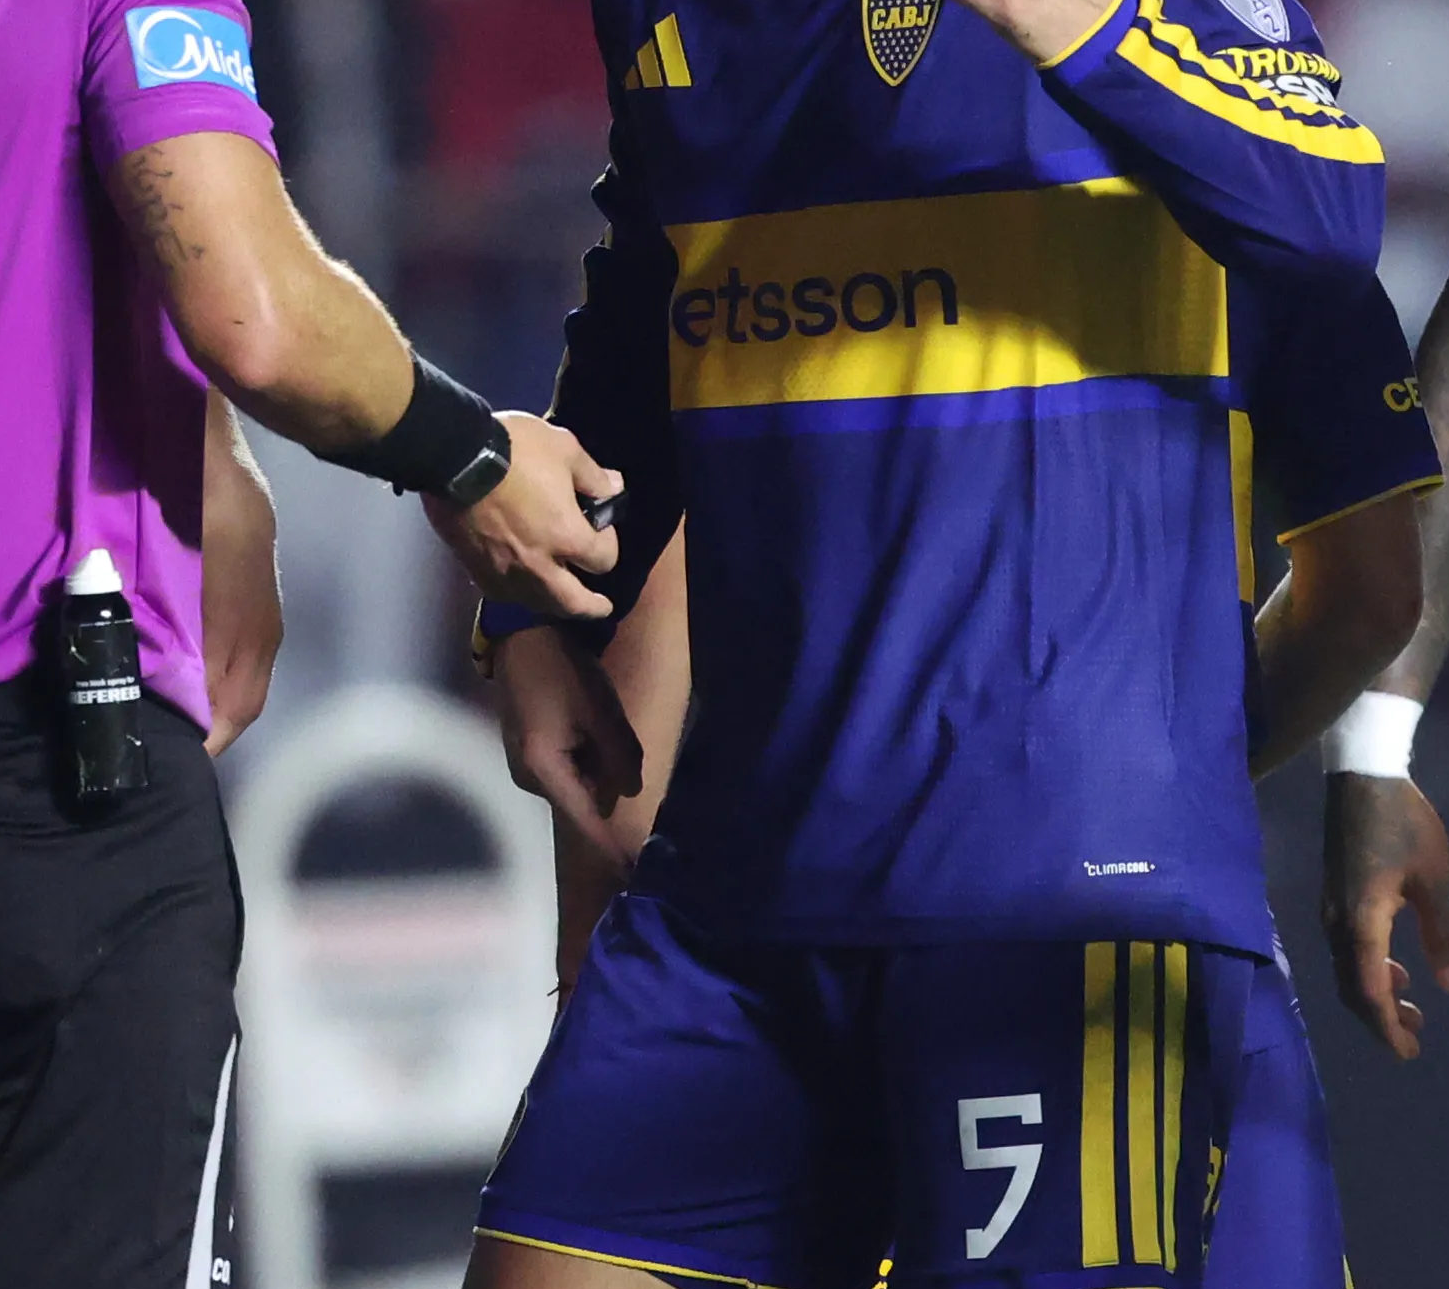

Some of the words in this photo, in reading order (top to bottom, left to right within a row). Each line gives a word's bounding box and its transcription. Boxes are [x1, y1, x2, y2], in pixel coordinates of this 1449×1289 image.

[871, 4, 931, 30] CABJ
[671, 266, 959, 348] etsson
[957, 1092, 1044, 1260] 5
